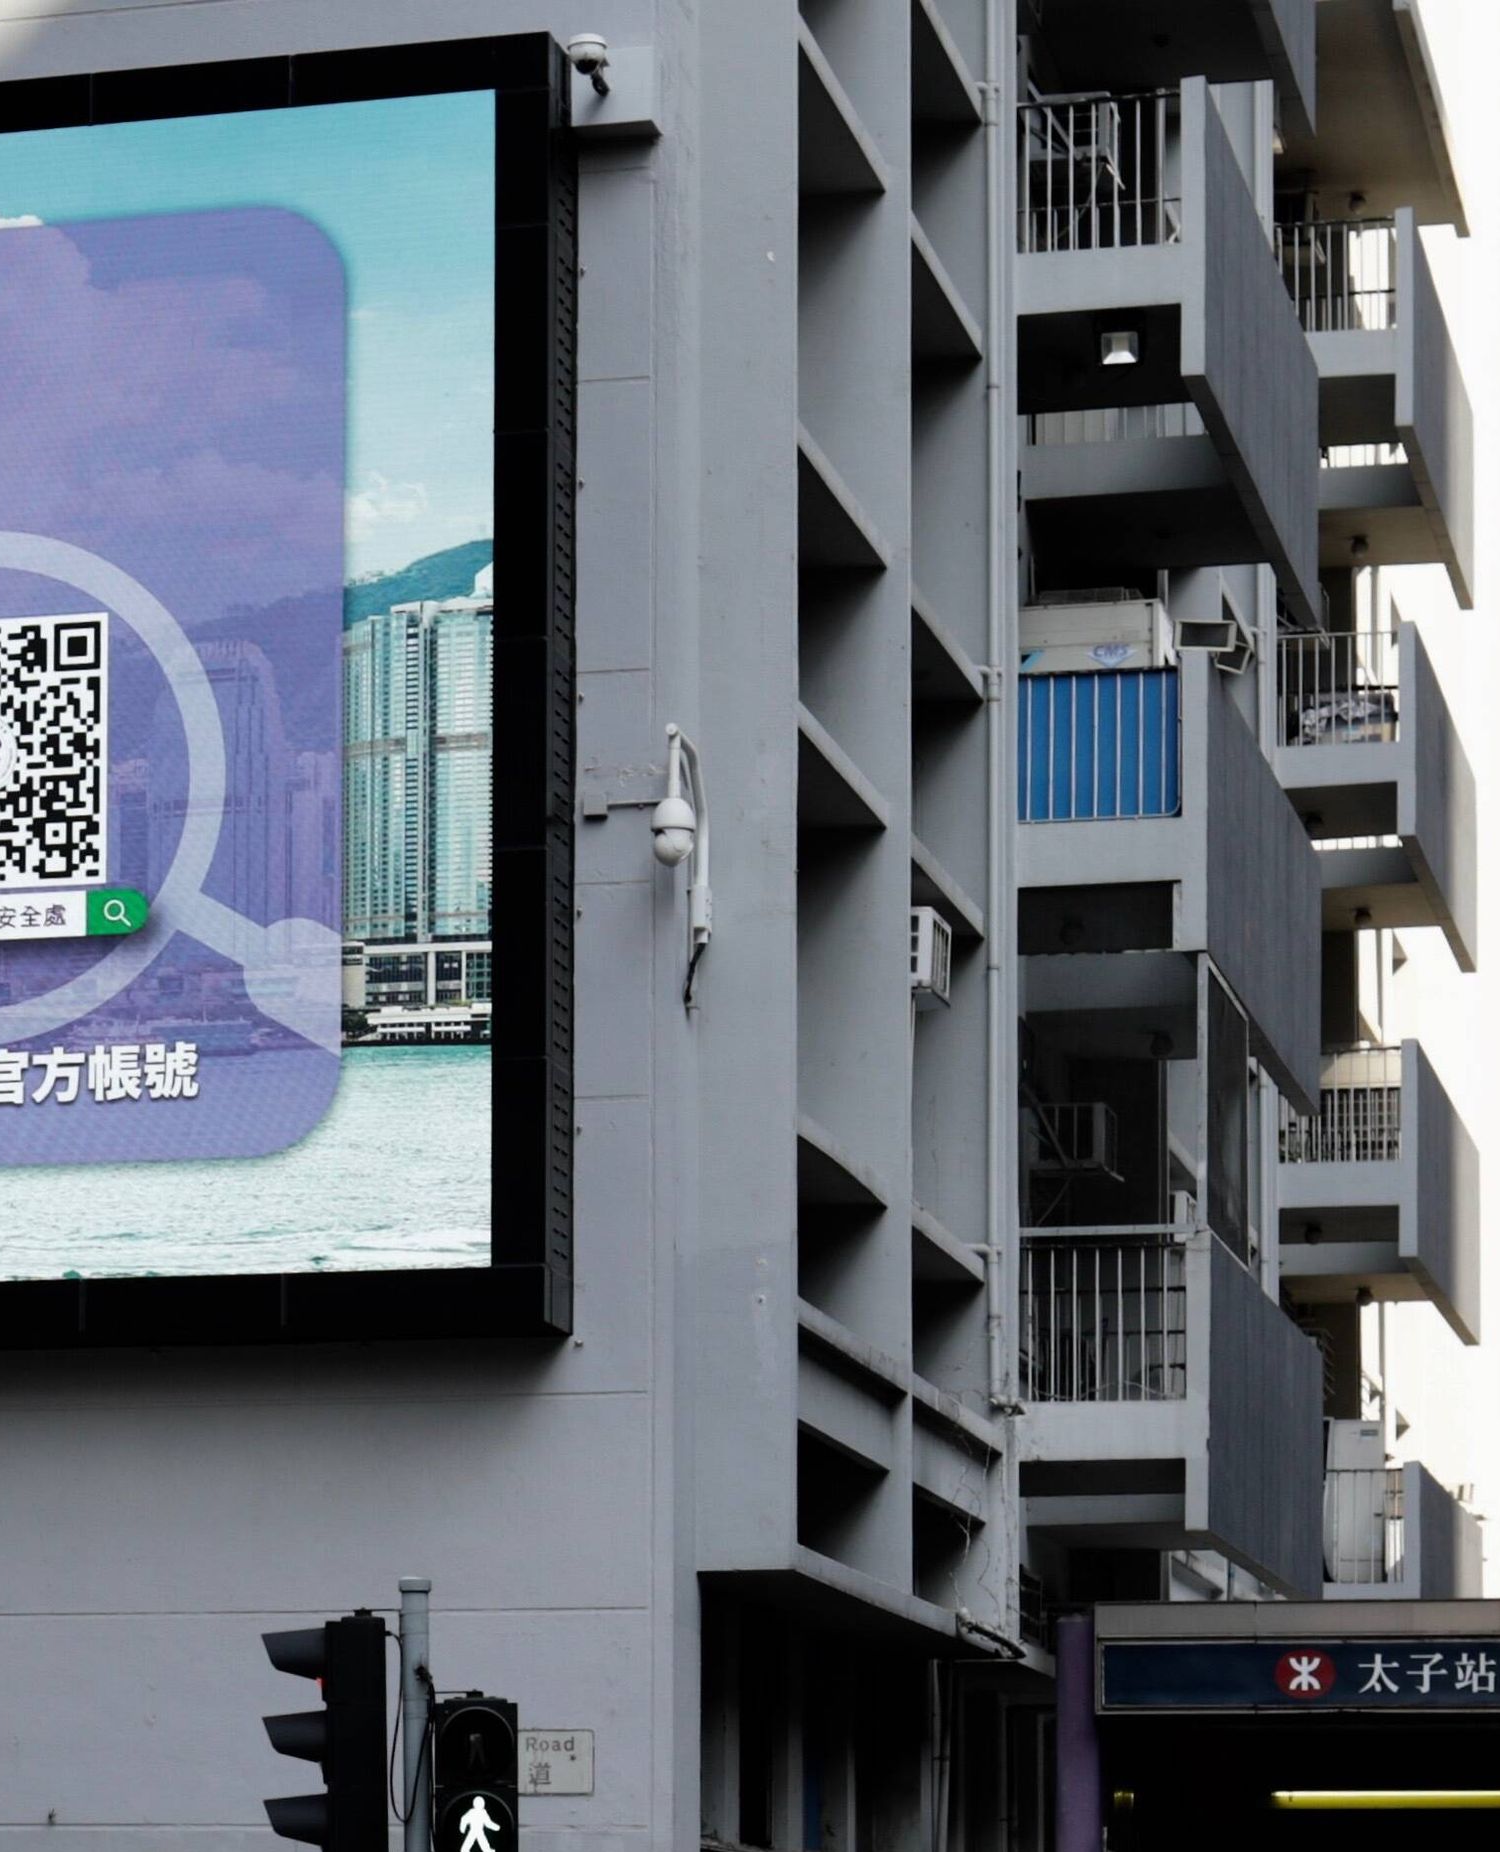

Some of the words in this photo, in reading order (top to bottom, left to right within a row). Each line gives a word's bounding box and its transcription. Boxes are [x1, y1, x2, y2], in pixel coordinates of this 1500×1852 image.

[1357, 1652, 1496, 1694] 太子站
[525, 1736, 575, 1752] Road
[528, 1762, 551, 1786] 道
